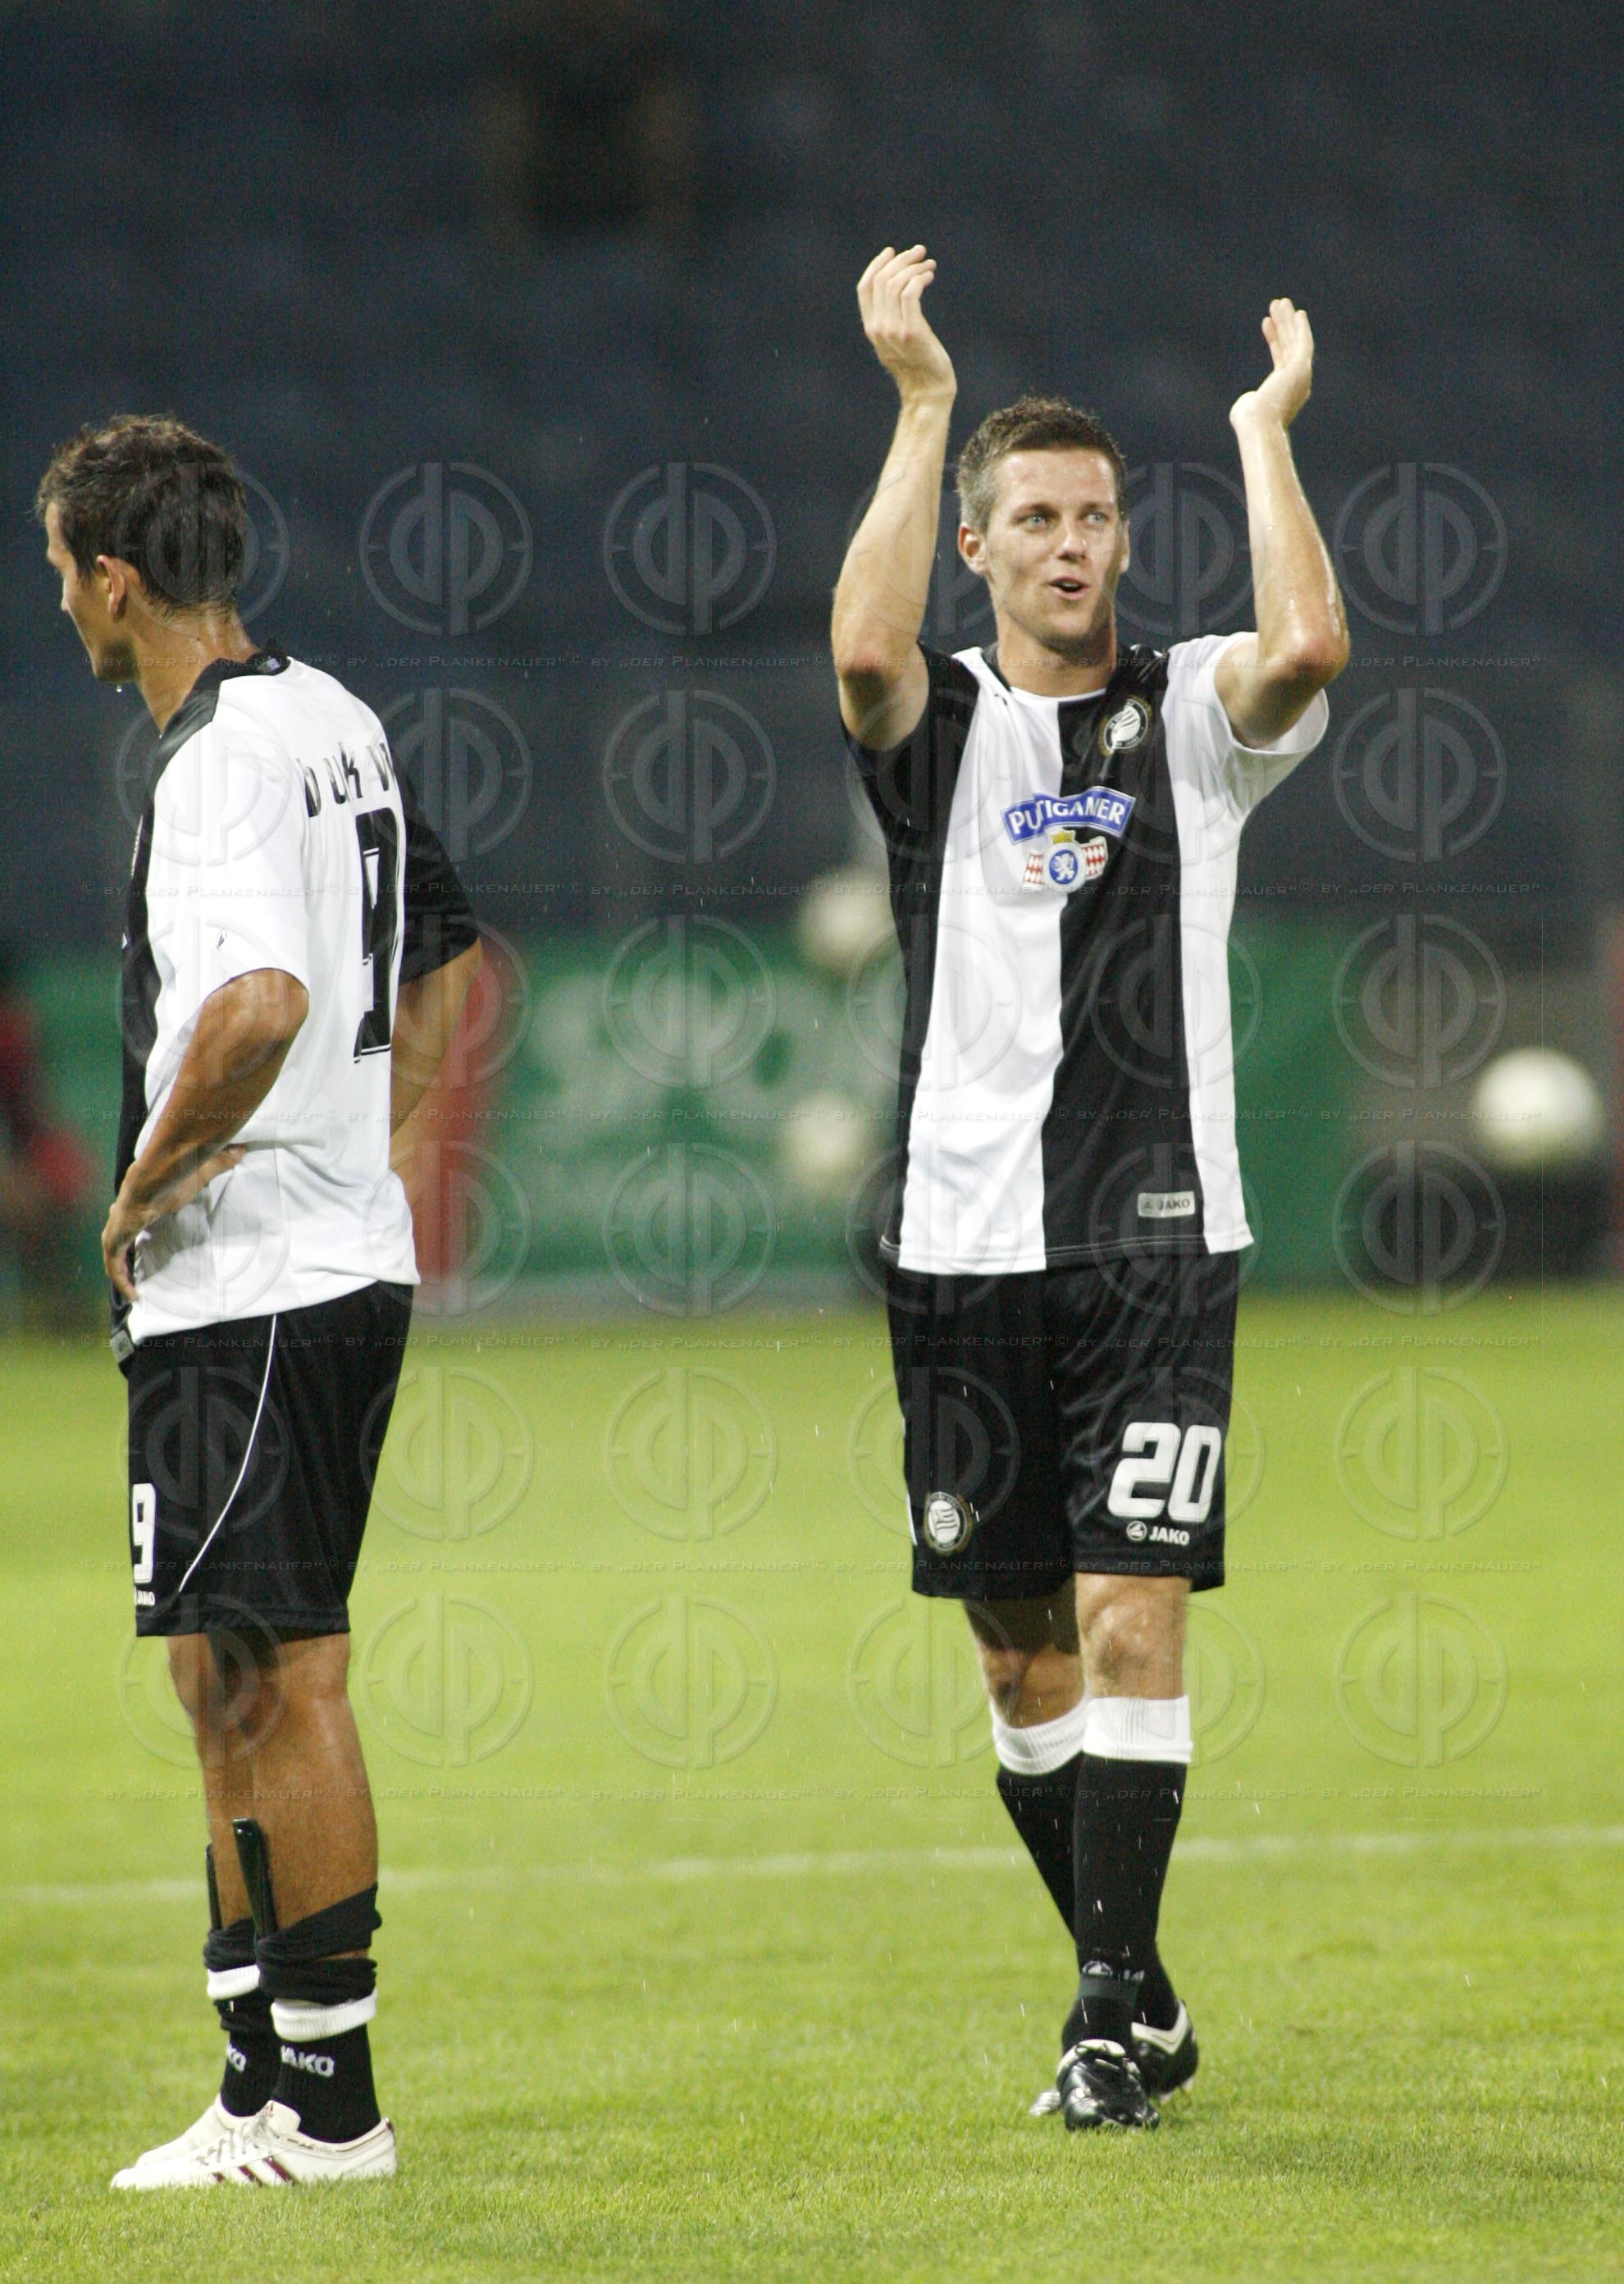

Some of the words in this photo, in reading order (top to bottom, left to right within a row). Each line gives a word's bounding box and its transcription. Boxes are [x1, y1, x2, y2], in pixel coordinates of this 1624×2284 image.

[1157, 1199, 1190, 1211] JAKO
[1107, 1422, 1221, 1523] 20
[132, 1483, 156, 1583] 9
[1149, 1525, 1190, 1546] JAKO
